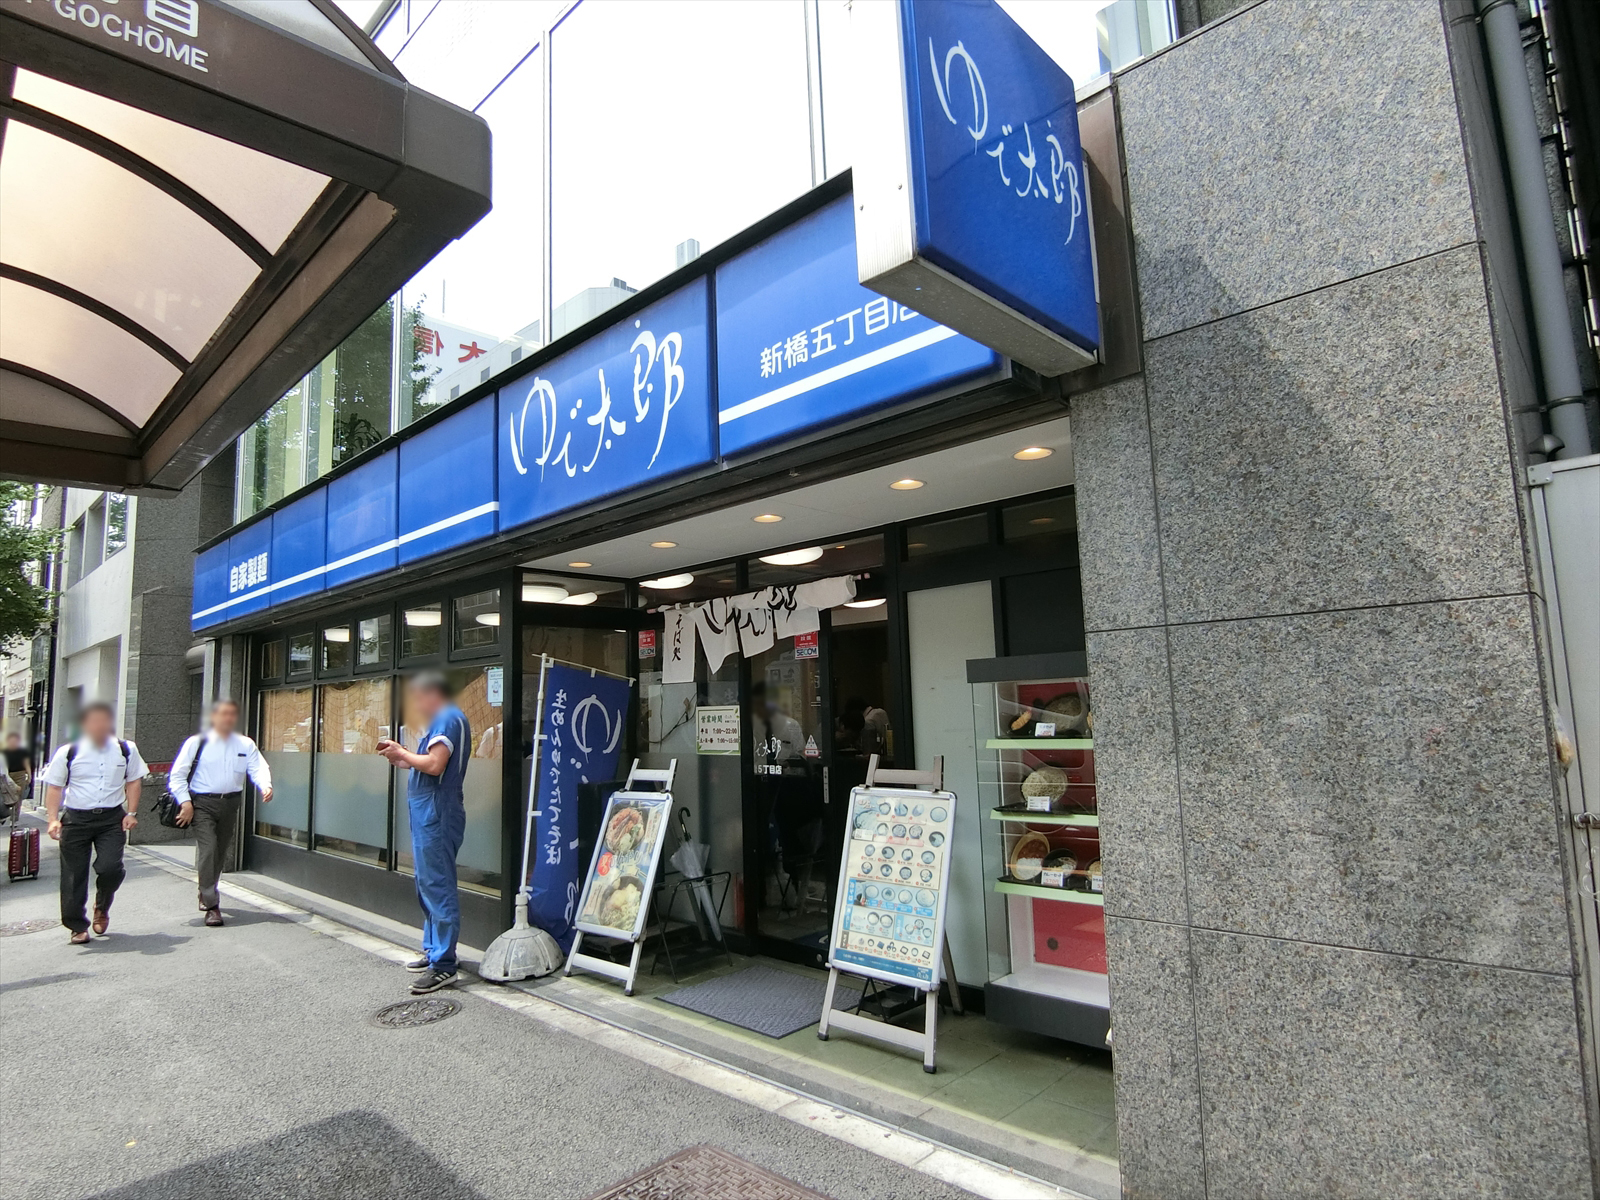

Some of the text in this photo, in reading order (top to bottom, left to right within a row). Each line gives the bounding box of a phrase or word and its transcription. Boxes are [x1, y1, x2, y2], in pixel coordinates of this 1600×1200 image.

[928, 37, 1082, 246] ゆで太郎
[510, 320, 685, 482] ゆで太郎
[796, 648, 817, 656] SECOM
[701, 715, 723, 723] 営業時間
[754, 735, 782, 760] で太郎
